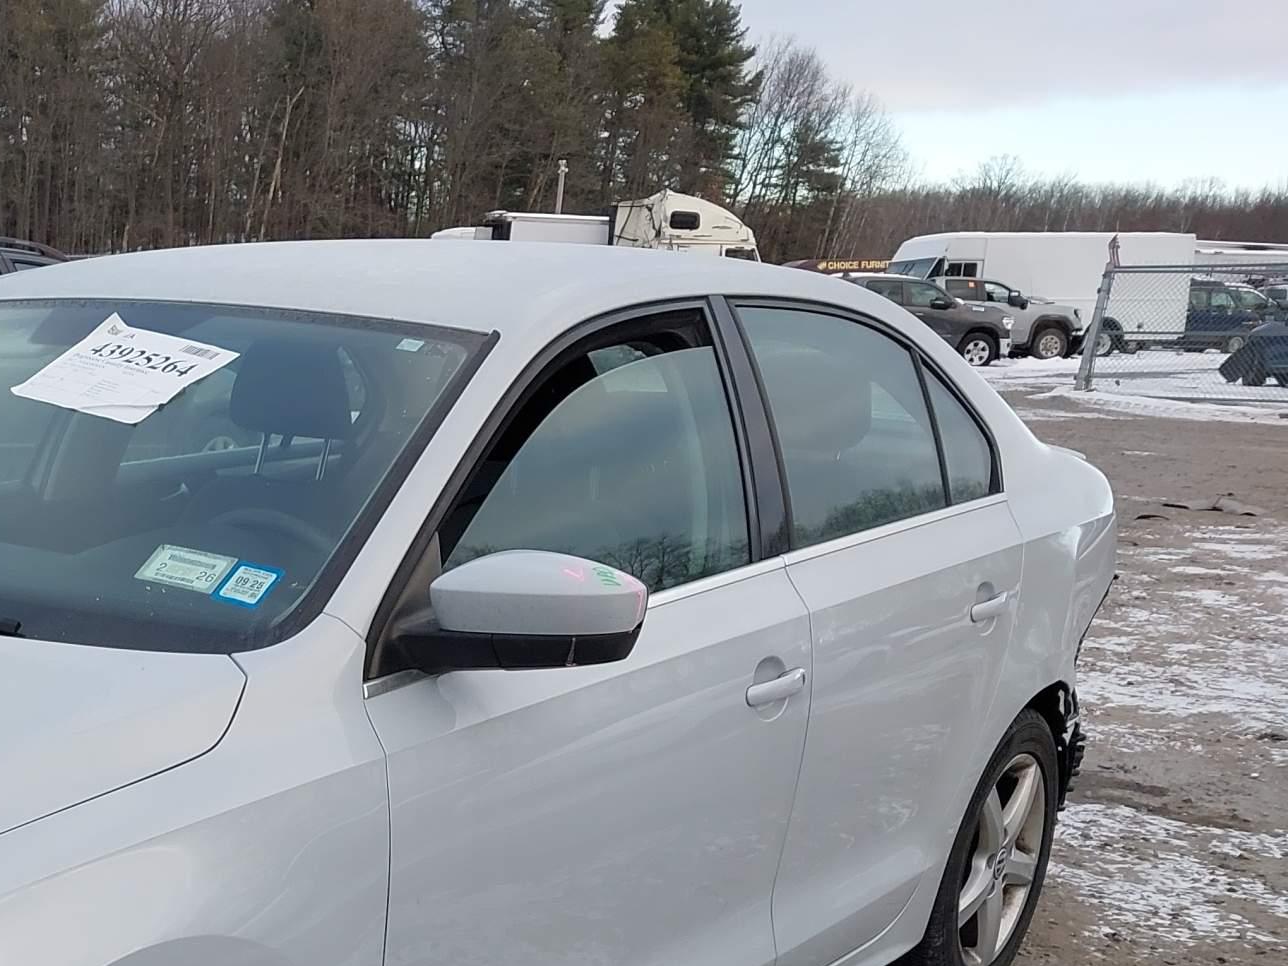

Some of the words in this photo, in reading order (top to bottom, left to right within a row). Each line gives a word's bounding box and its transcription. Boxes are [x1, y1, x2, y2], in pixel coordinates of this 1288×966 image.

[827, 261, 859, 269] CHOICE
[91, 342, 200, 378] 43925264
[156, 562, 168, 571] 2
[196, 570, 217, 583] 26
